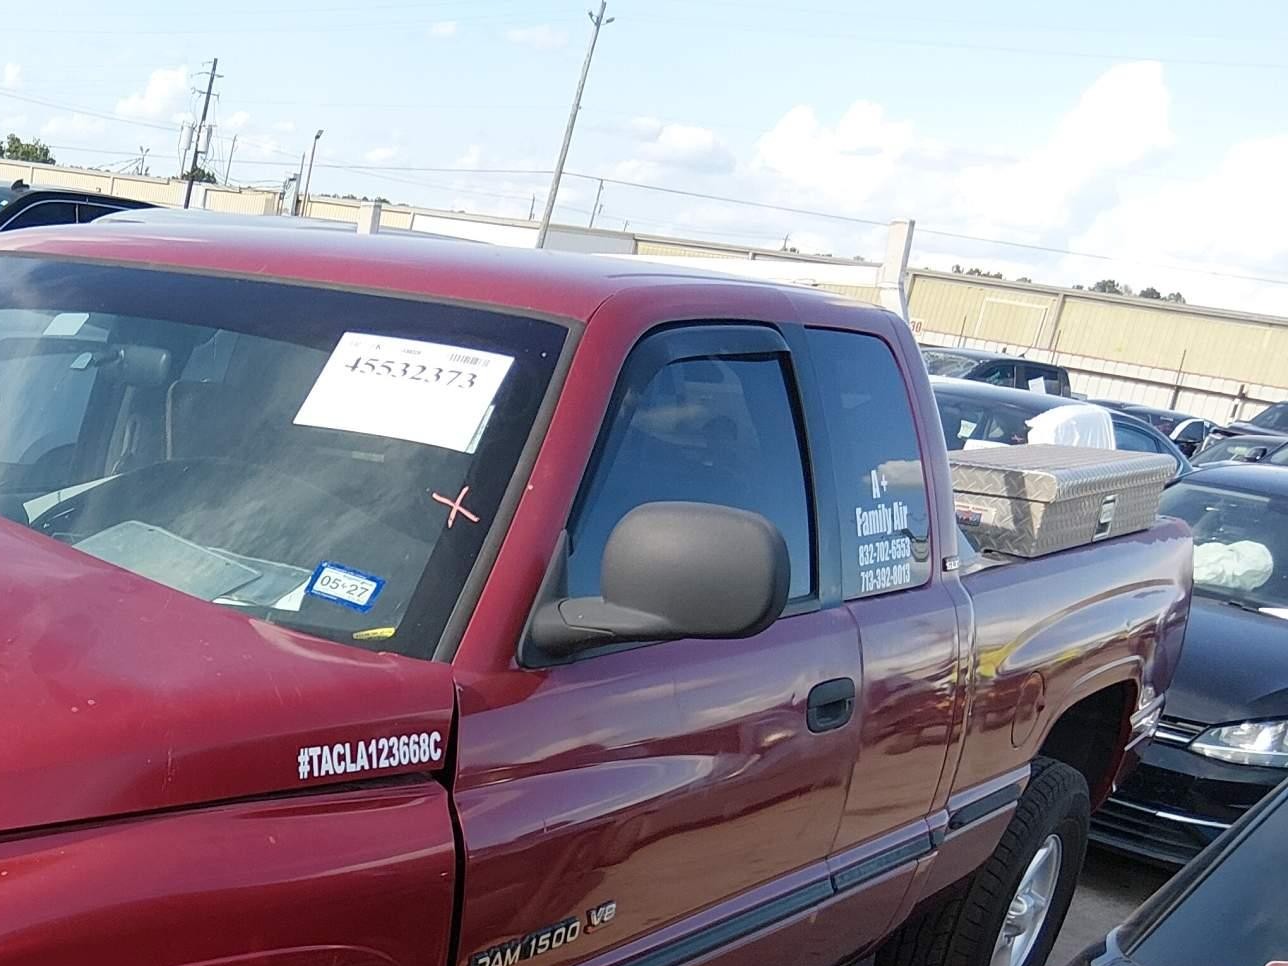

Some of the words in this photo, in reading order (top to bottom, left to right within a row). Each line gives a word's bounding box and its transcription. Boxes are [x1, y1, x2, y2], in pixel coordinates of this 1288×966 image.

[344, 356, 479, 389] 45532373
[855, 503, 892, 537] Family
[893, 501, 908, 531] Air
[858, 537, 911, 567] 832-702-6553
[861, 563, 911, 593] 713-392-8013
[297, 731, 442, 780] #TACLA123668C
[529, 920, 581, 958] 1500
[589, 902, 617, 927] V8
